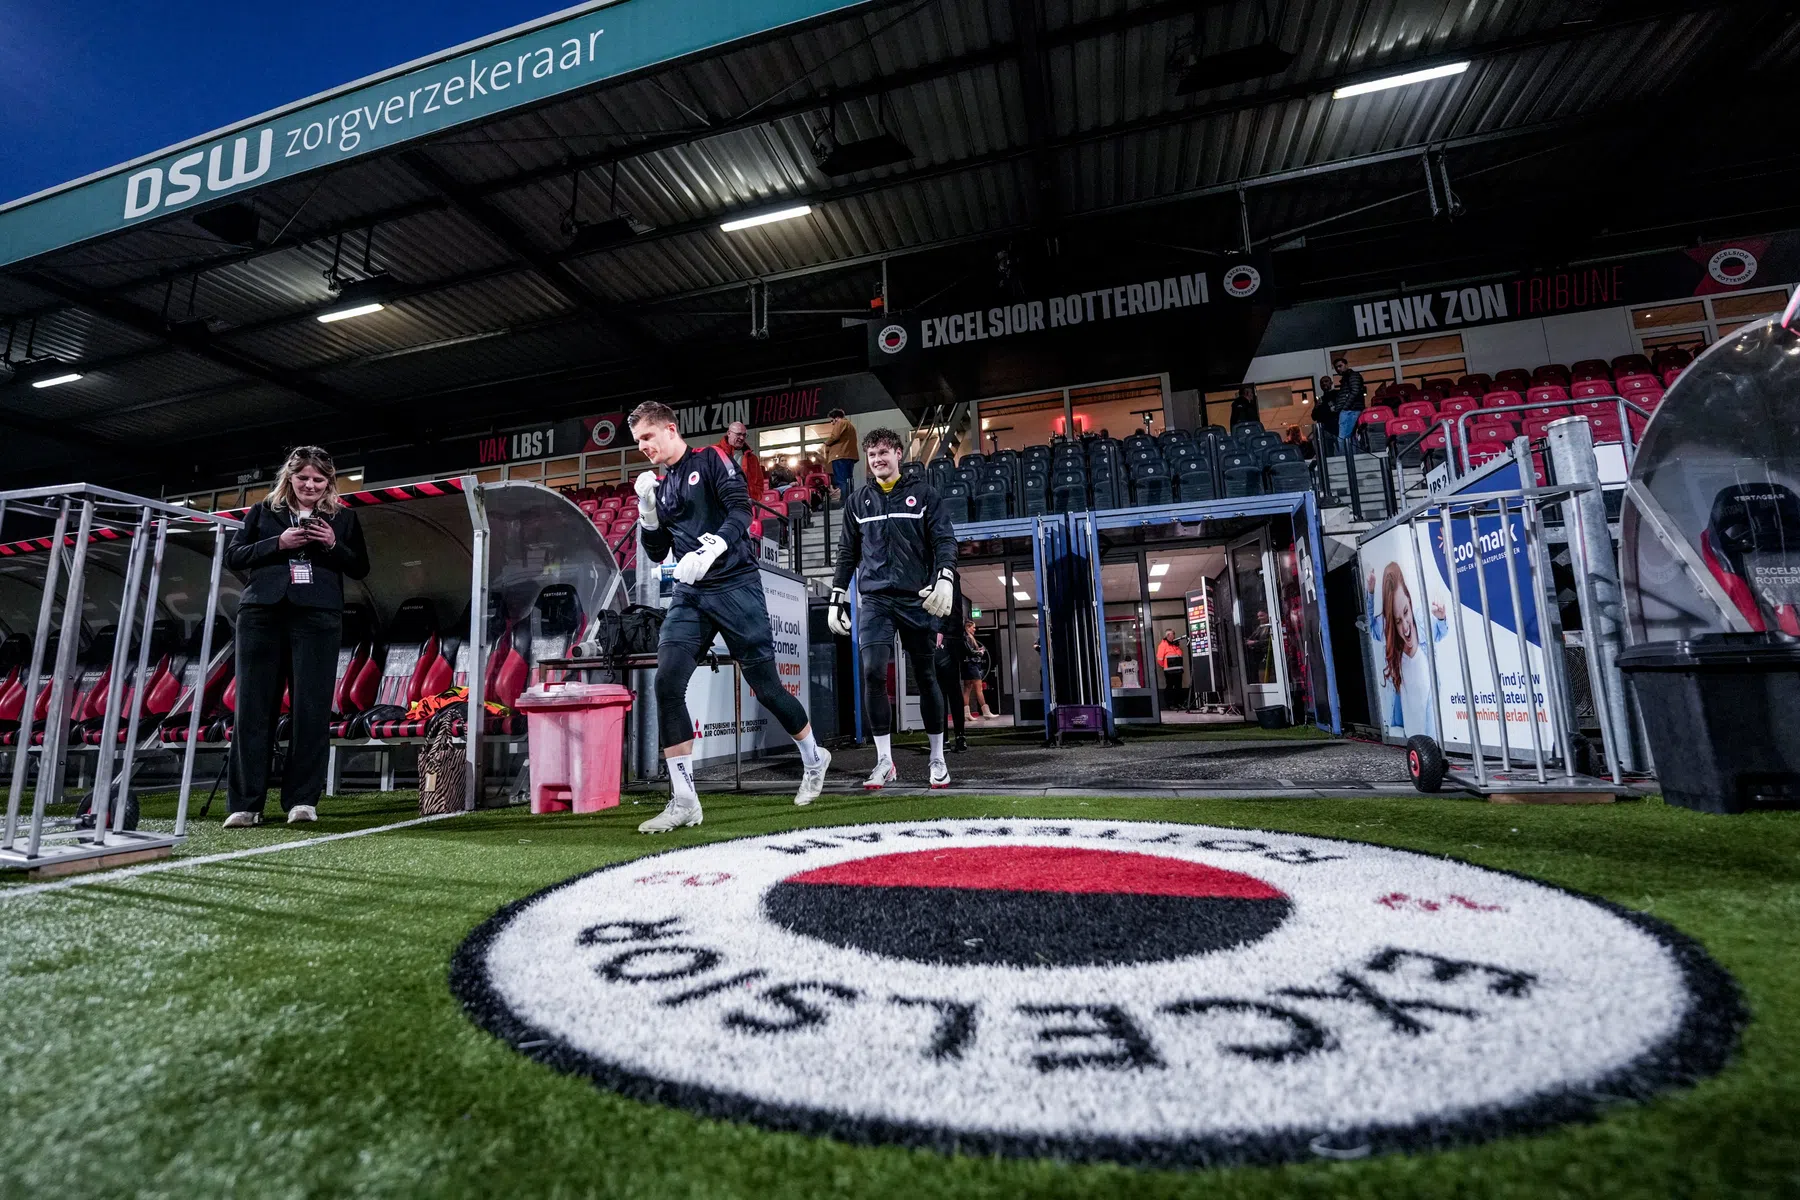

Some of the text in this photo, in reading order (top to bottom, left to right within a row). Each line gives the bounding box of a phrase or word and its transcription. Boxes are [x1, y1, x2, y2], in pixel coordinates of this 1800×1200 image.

[123, 28, 604, 220] DSW zorgverzekeraar
[921, 272, 1209, 349] EXCELSIOR ROTTERDAM
[1353, 265, 1625, 338] HENK ZON TRIBUNE
[675, 387, 823, 435] ENK ZON TRIBUNE
[479, 429, 555, 464] VAK LBS 1
[764, 545, 778, 563] LBS 1
[784, 620, 801, 636] cool
[772, 641, 800, 658] zomer,
[778, 663, 801, 676] warm
[1517, 671, 1540, 689] jow
[1450, 692, 1479, 704] erkee
[704, 721, 730, 731] MITSUBISHI
[704, 730, 713, 738] AIR
[746, 725, 762, 733] EUROPE
[575, 916, 1540, 1072] EXCELSIOR
